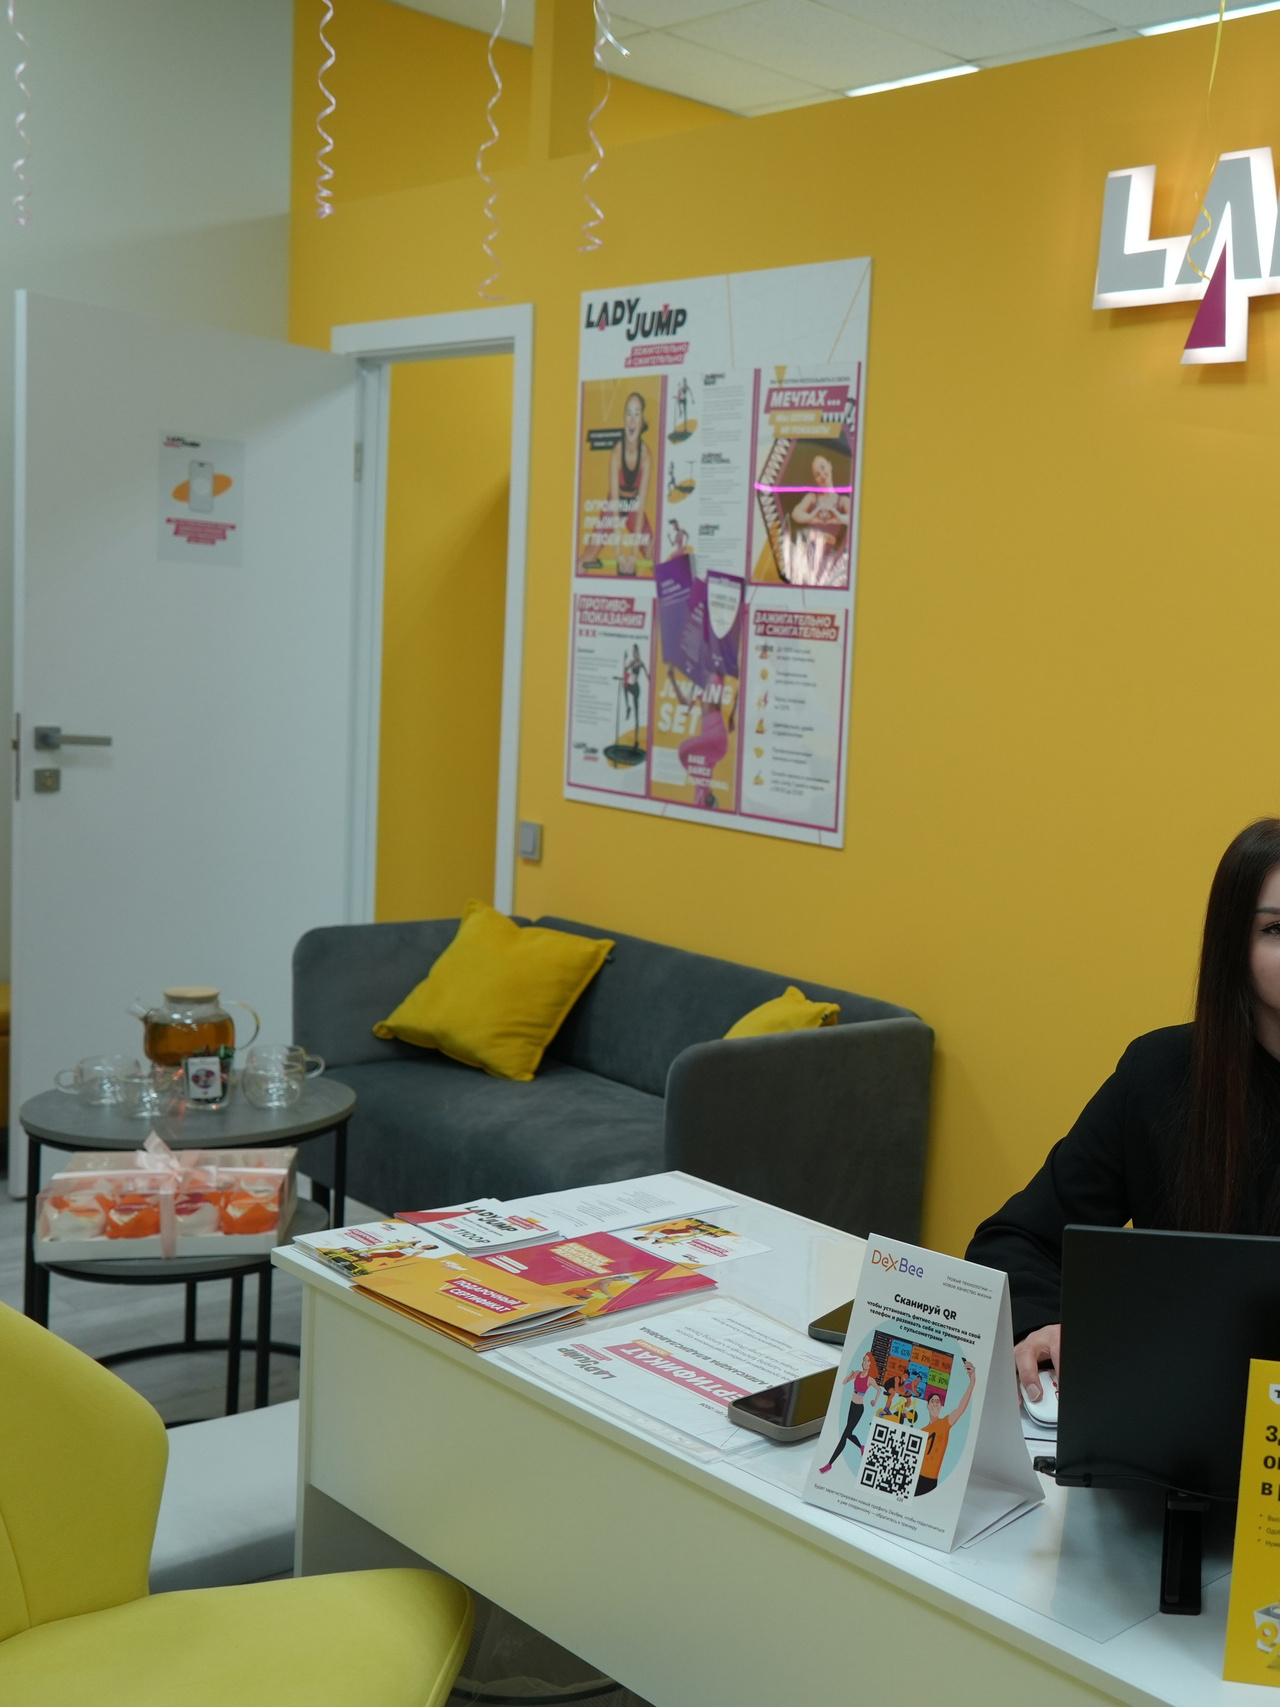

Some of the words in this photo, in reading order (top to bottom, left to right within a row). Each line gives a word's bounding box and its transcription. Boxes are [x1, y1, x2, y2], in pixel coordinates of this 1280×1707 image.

[585, 297, 640, 331] LADY
[626, 304, 687, 341] JUMP
[658, 702, 702, 735] SET
[464, 1206, 498, 1221] LADY
[478, 1214, 518, 1232] JUMP
[453, 1279, 521, 1306] ПОДАРОЧНЫЙ
[942, 1282, 956, 1290] новое
[957, 1286, 976, 1296] качество
[962, 1280, 988, 1292] технологии
[449, 1288, 512, 1312] СЕРТИФИКАТ
[894, 1293, 940, 1315] Сканируй
[943, 1308, 957, 1320] QR
[867, 1301, 882, 1309] чтобы
[883, 1304, 911, 1318] установить
[912, 1313, 960, 1333] фитнес-ассистента
[968, 1331, 981, 1340] свой
[869, 1308, 891, 1319] телефон
[896, 1316, 921, 1328] развивать
[922, 1324, 934, 1332] себя
[942, 1330, 976, 1345] тренировках
[903, 1326, 943, 1342] пульсометрами
[557, 1347, 599, 1366] JUMP
[578, 1361, 617, 1379] LADY
[618, 1346, 745, 1400] ЕРТИФИКАТ
[1260, 1481, 1273, 1496] в
